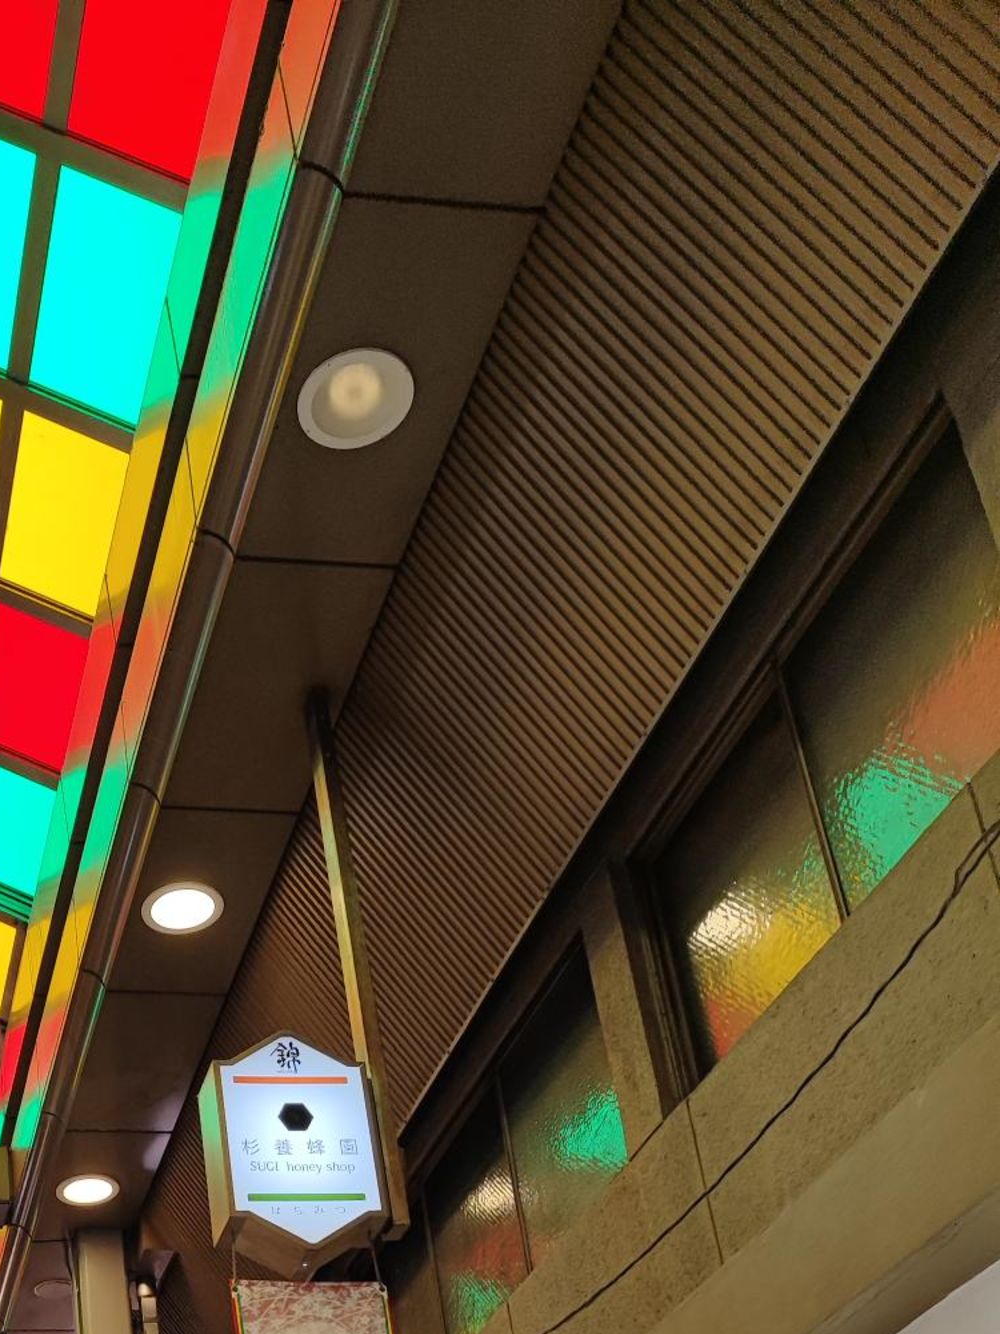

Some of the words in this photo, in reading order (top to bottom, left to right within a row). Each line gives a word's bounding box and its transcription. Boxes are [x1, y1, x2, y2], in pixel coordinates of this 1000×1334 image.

[270, 1041, 302, 1073] 錦
[241, 1138, 359, 1156] 杉養蜂園
[250, 1160, 279, 1172] SUGI
[286, 1160, 322, 1174] honey
[325, 1160, 356, 1173] shop
[271, 1204, 347, 1215] はちみつ
